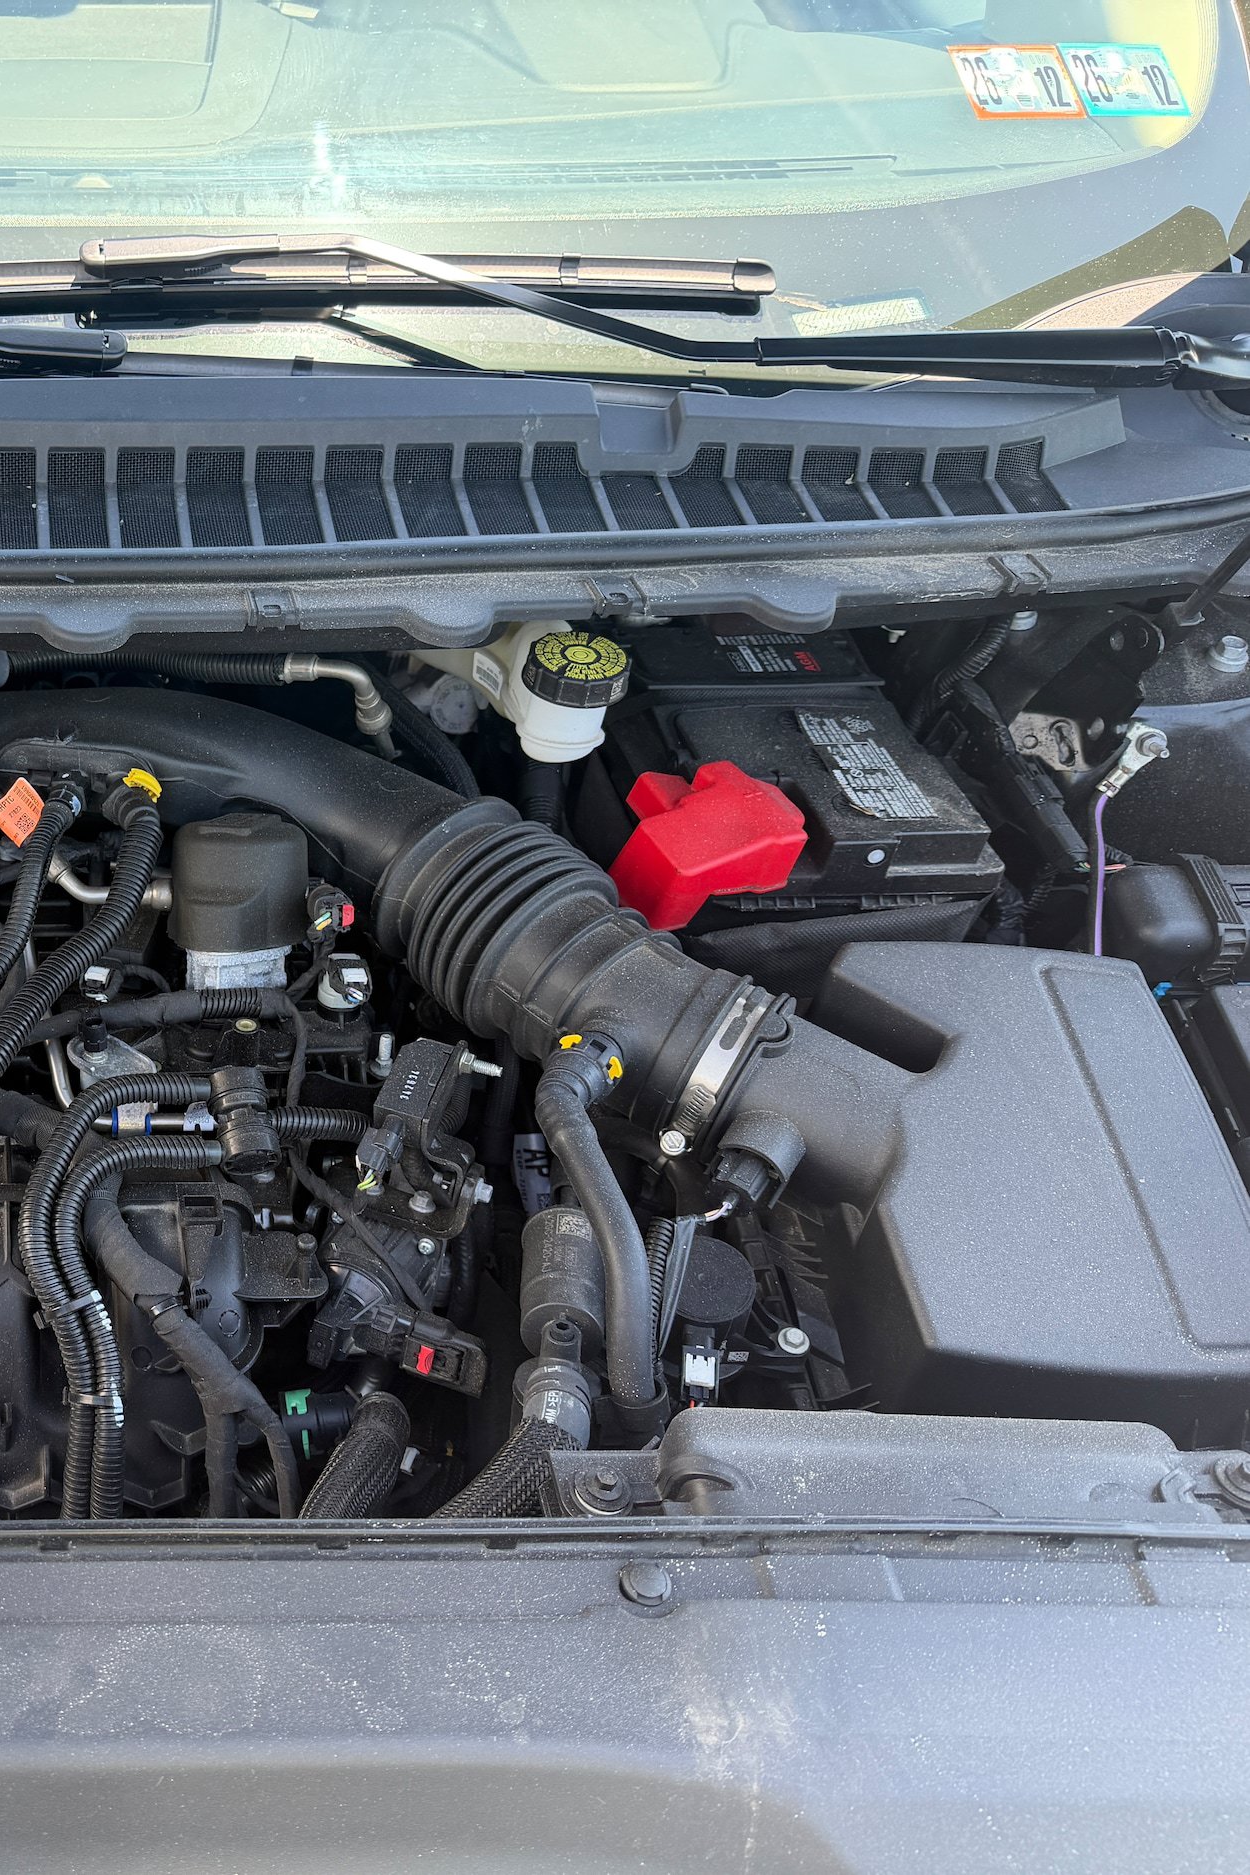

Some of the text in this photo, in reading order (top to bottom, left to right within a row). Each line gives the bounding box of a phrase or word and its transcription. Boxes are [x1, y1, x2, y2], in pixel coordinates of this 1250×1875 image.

[960, 56, 1003, 105] 26
[1034, 66, 1072, 107] 12
[1072, 54, 1114, 103] 26
[1142, 64, 1179, 106] 12
[794, 651, 817, 672] AGM
[523, 1148, 551, 1177] AP
